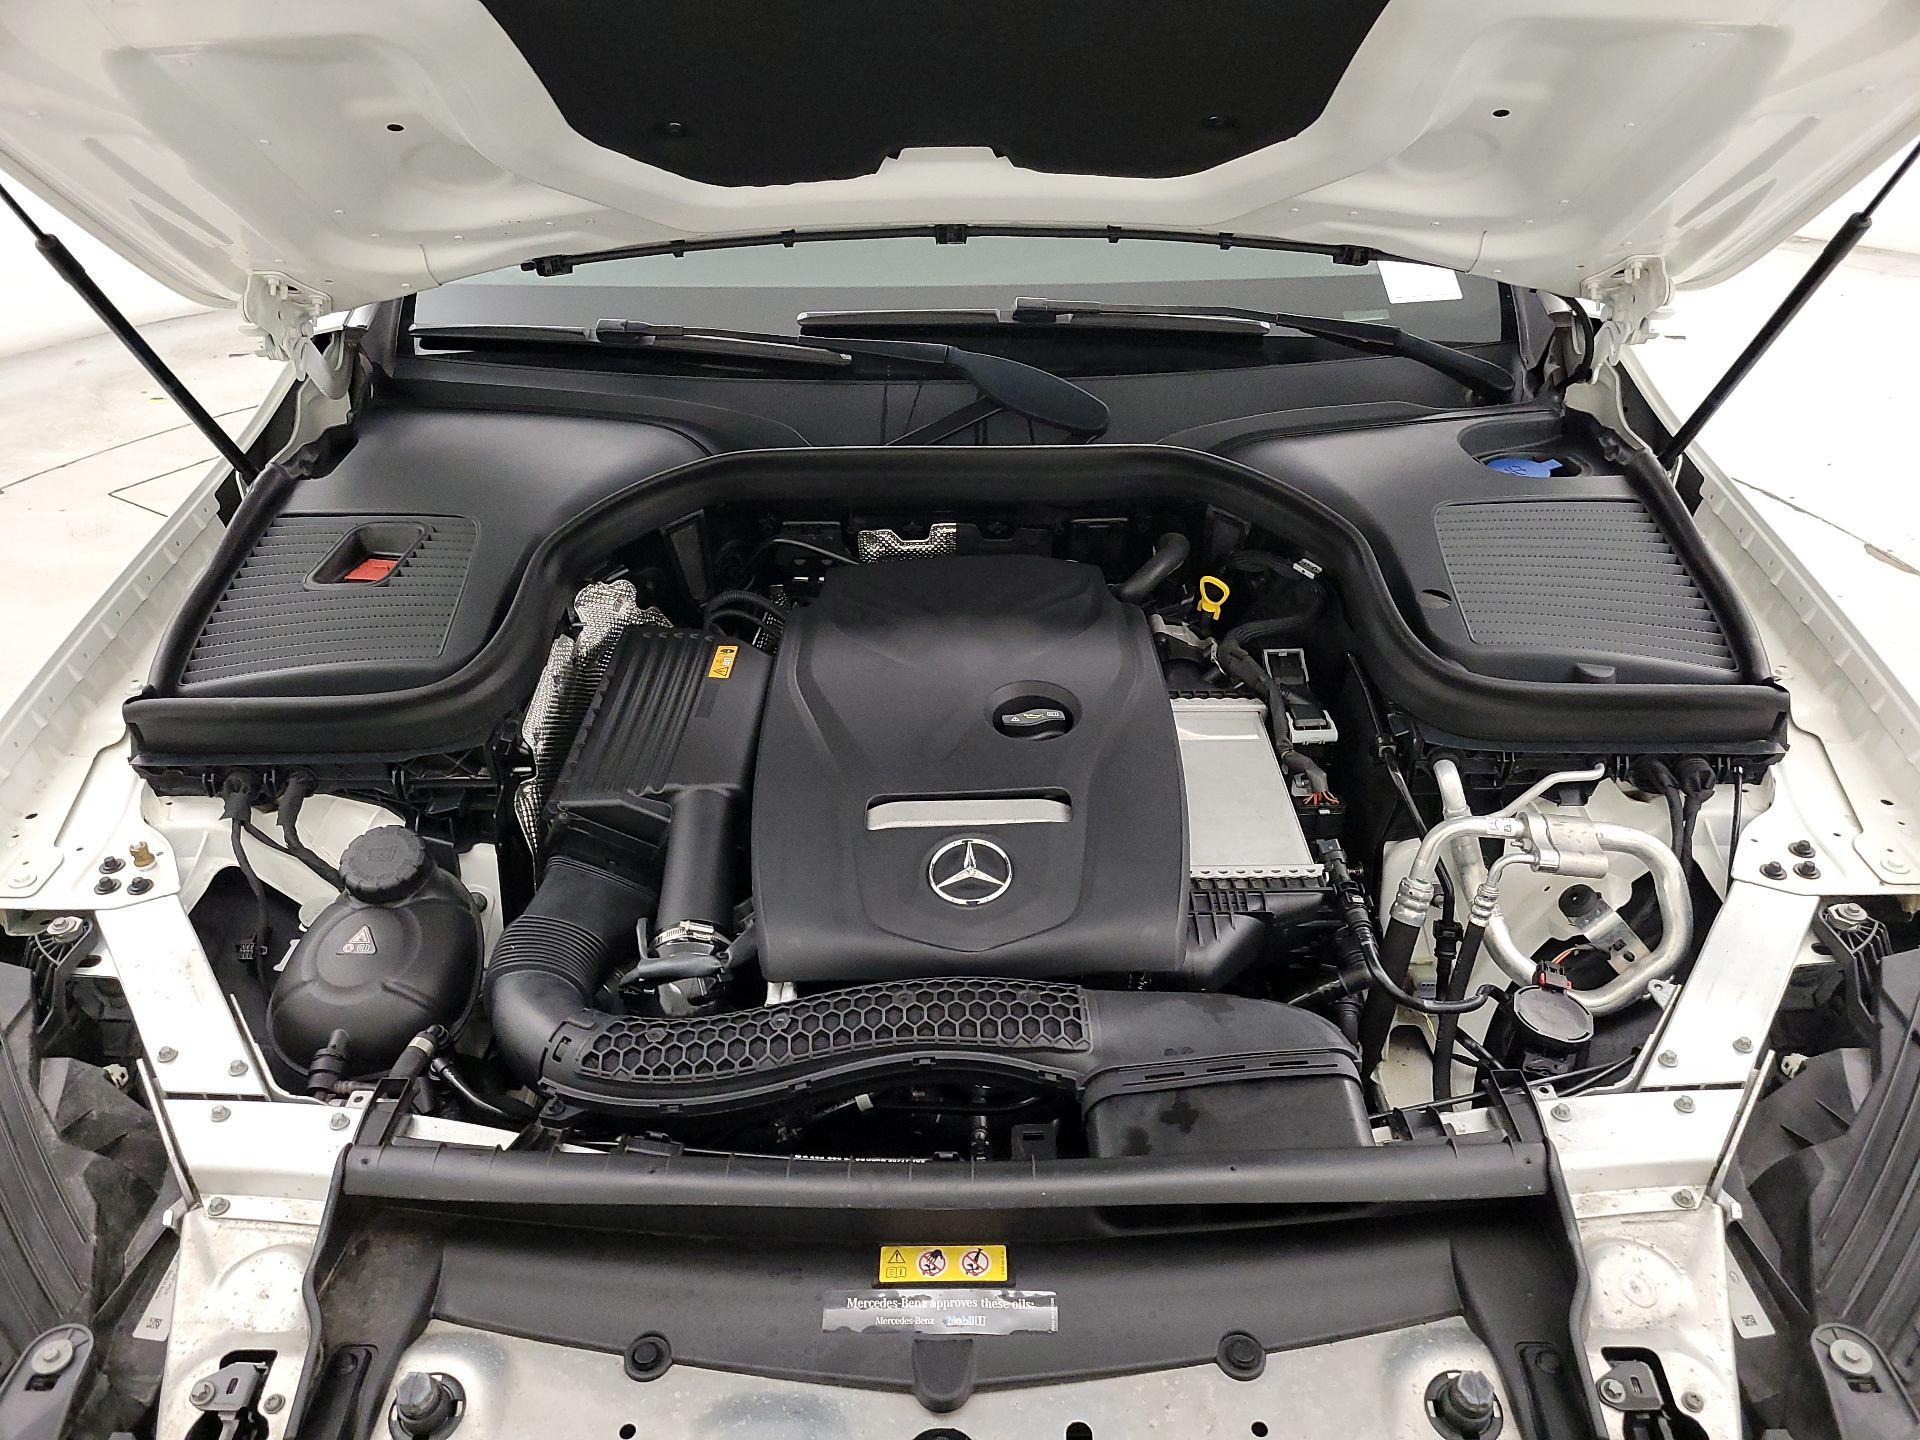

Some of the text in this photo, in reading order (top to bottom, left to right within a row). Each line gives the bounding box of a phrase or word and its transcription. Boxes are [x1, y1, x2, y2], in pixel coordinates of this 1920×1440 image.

[846, 1297, 928, 1309] Mercedes-Benz
[930, 1297, 977, 1311] approves
[980, 1297, 1010, 1310] these
[875, 1316, 934, 1325] Mercedes-Benz
